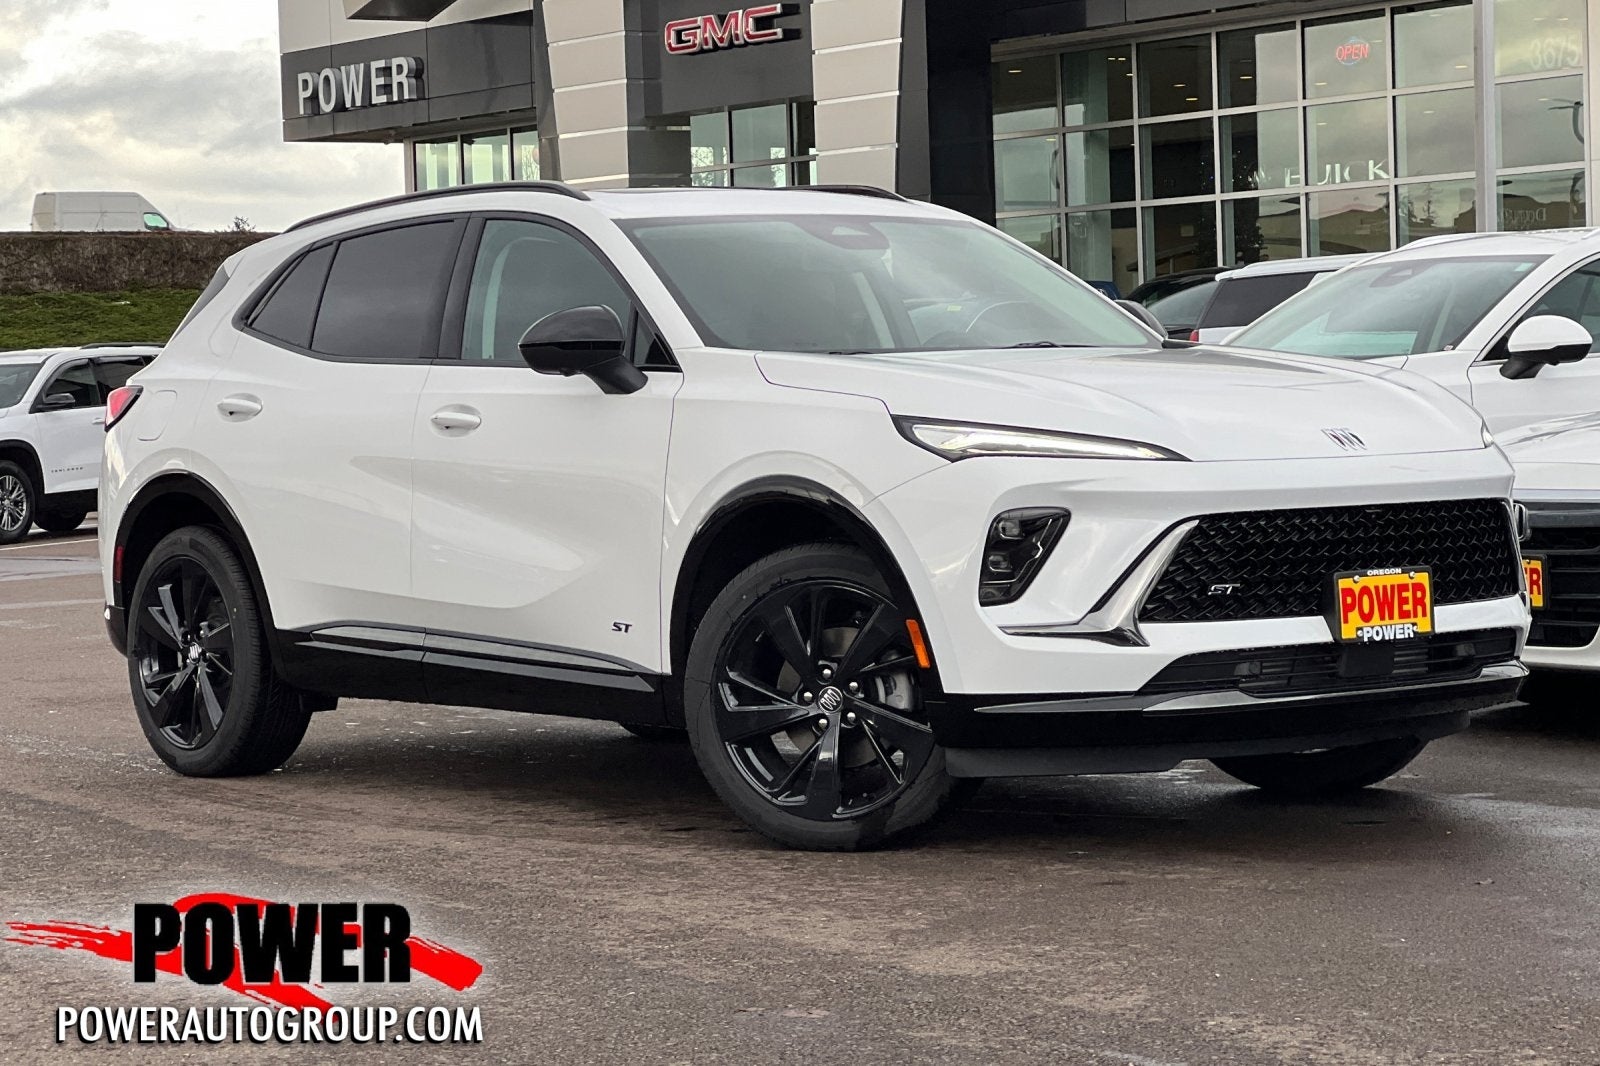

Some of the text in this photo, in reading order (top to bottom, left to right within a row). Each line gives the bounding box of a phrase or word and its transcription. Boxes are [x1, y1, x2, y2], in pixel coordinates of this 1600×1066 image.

[664, 3, 783, 54] GMC
[1335, 43, 1369, 61] OPEN
[297, 56, 417, 116] POWER
[1366, 568, 1402, 576] OREGON
[1208, 583, 1240, 595] ST
[1341, 582, 1427, 624] POWER
[611, 621, 633, 633] ST
[1363, 623, 1414, 642] POWER
